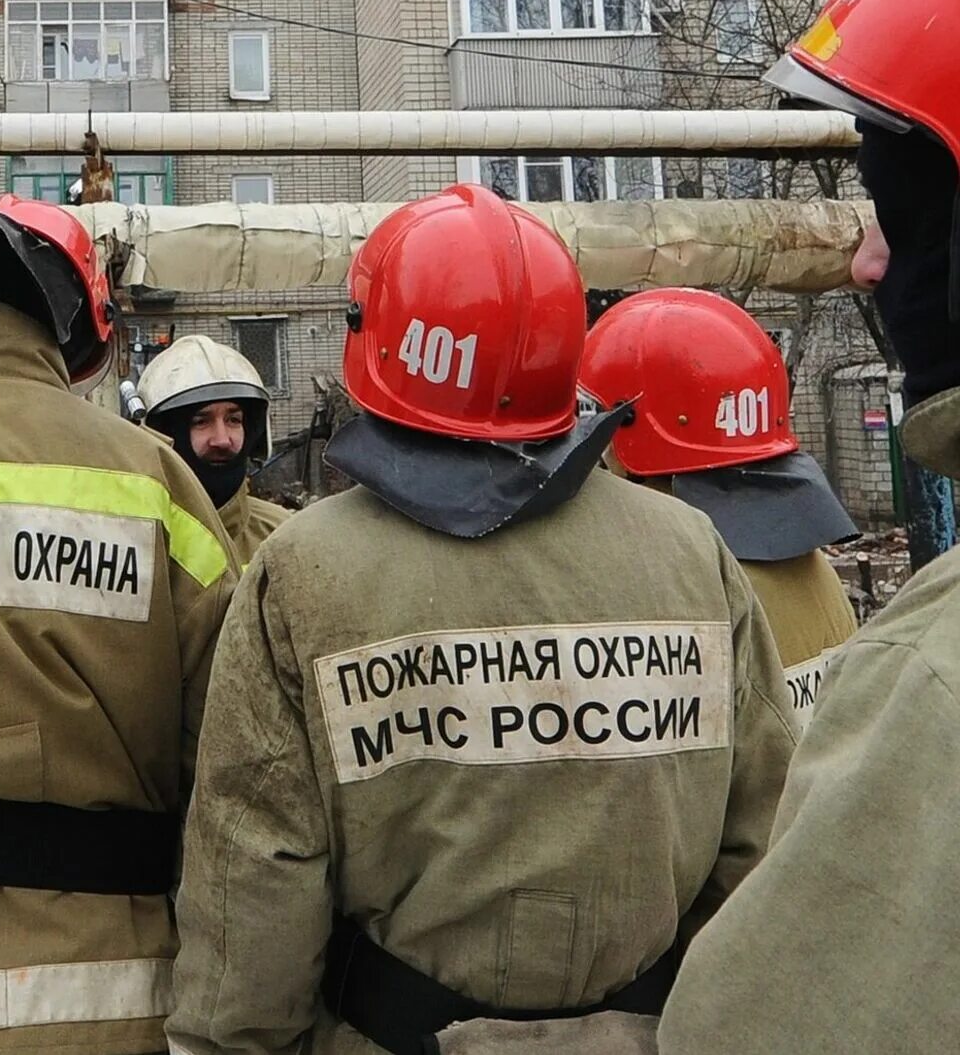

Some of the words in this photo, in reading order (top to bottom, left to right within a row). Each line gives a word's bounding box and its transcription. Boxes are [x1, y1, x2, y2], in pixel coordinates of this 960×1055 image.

[398, 318, 477, 389] 401
[715, 386, 769, 437] 401
[14, 530, 138, 594] ОХРАНА
[337, 639, 561, 706] ПОЖАРНАЯ
[573, 635, 702, 680] ОХРАНА
[350, 705, 469, 767] МЧС
[491, 696, 701, 748] РОССИИ
